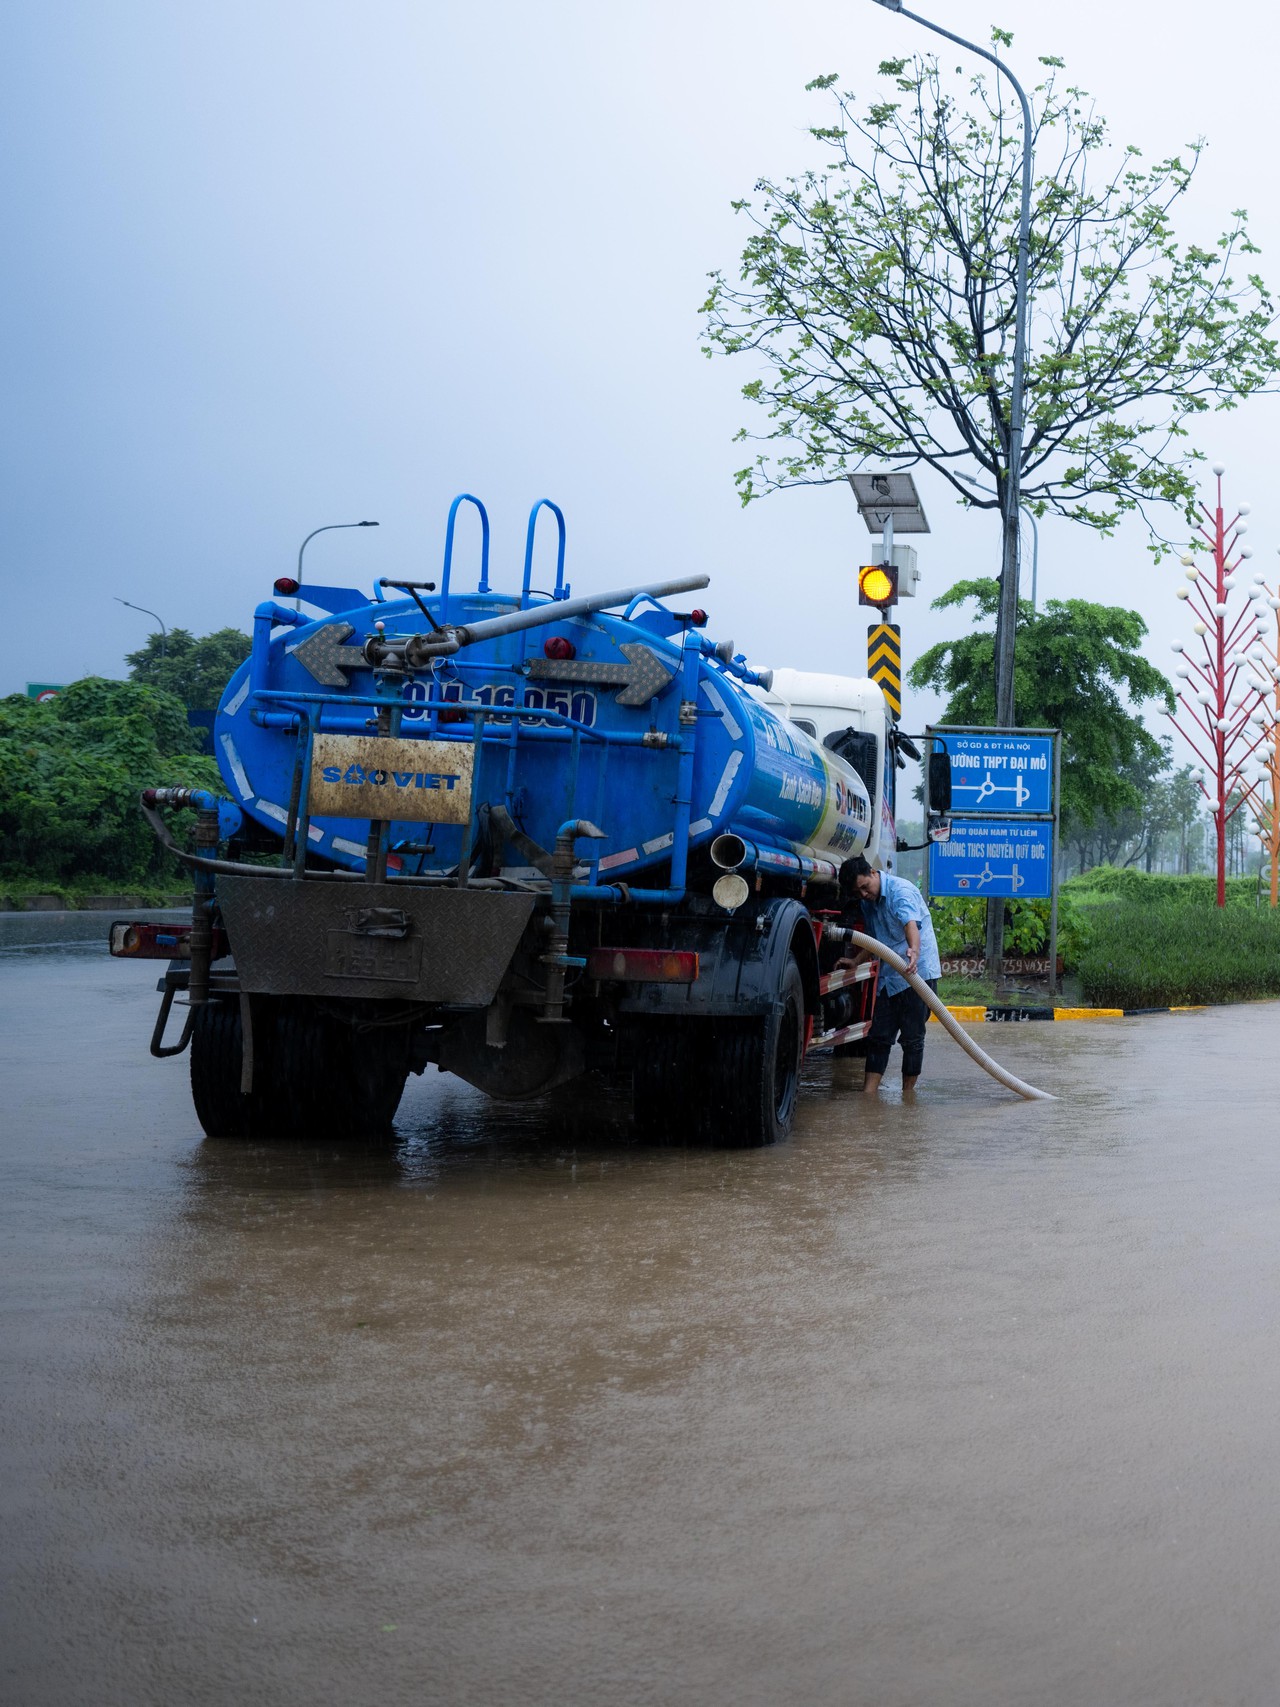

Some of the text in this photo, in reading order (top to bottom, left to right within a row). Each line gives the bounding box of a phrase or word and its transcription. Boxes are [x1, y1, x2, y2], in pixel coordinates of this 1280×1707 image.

[957, 740, 968, 749] SỞ
[1004, 741, 1015, 750] HÀ
[1017, 742, 1031, 751] NỘI
[950, 752, 1047, 772] ƯỜNG THPT ĐẠI MỖ
[951, 828, 967, 836] BND
[968, 827, 989, 837] QUẬN
[990, 828, 1008, 836] NAM
[1020, 828, 1038, 837] LIÊM
[938, 838, 966, 858] TRƯỜNG
[968, 842, 985, 858] THCS
[986, 838, 1015, 859] NGUYỄN
[1030, 840, 1045, 860] ĐỨC
